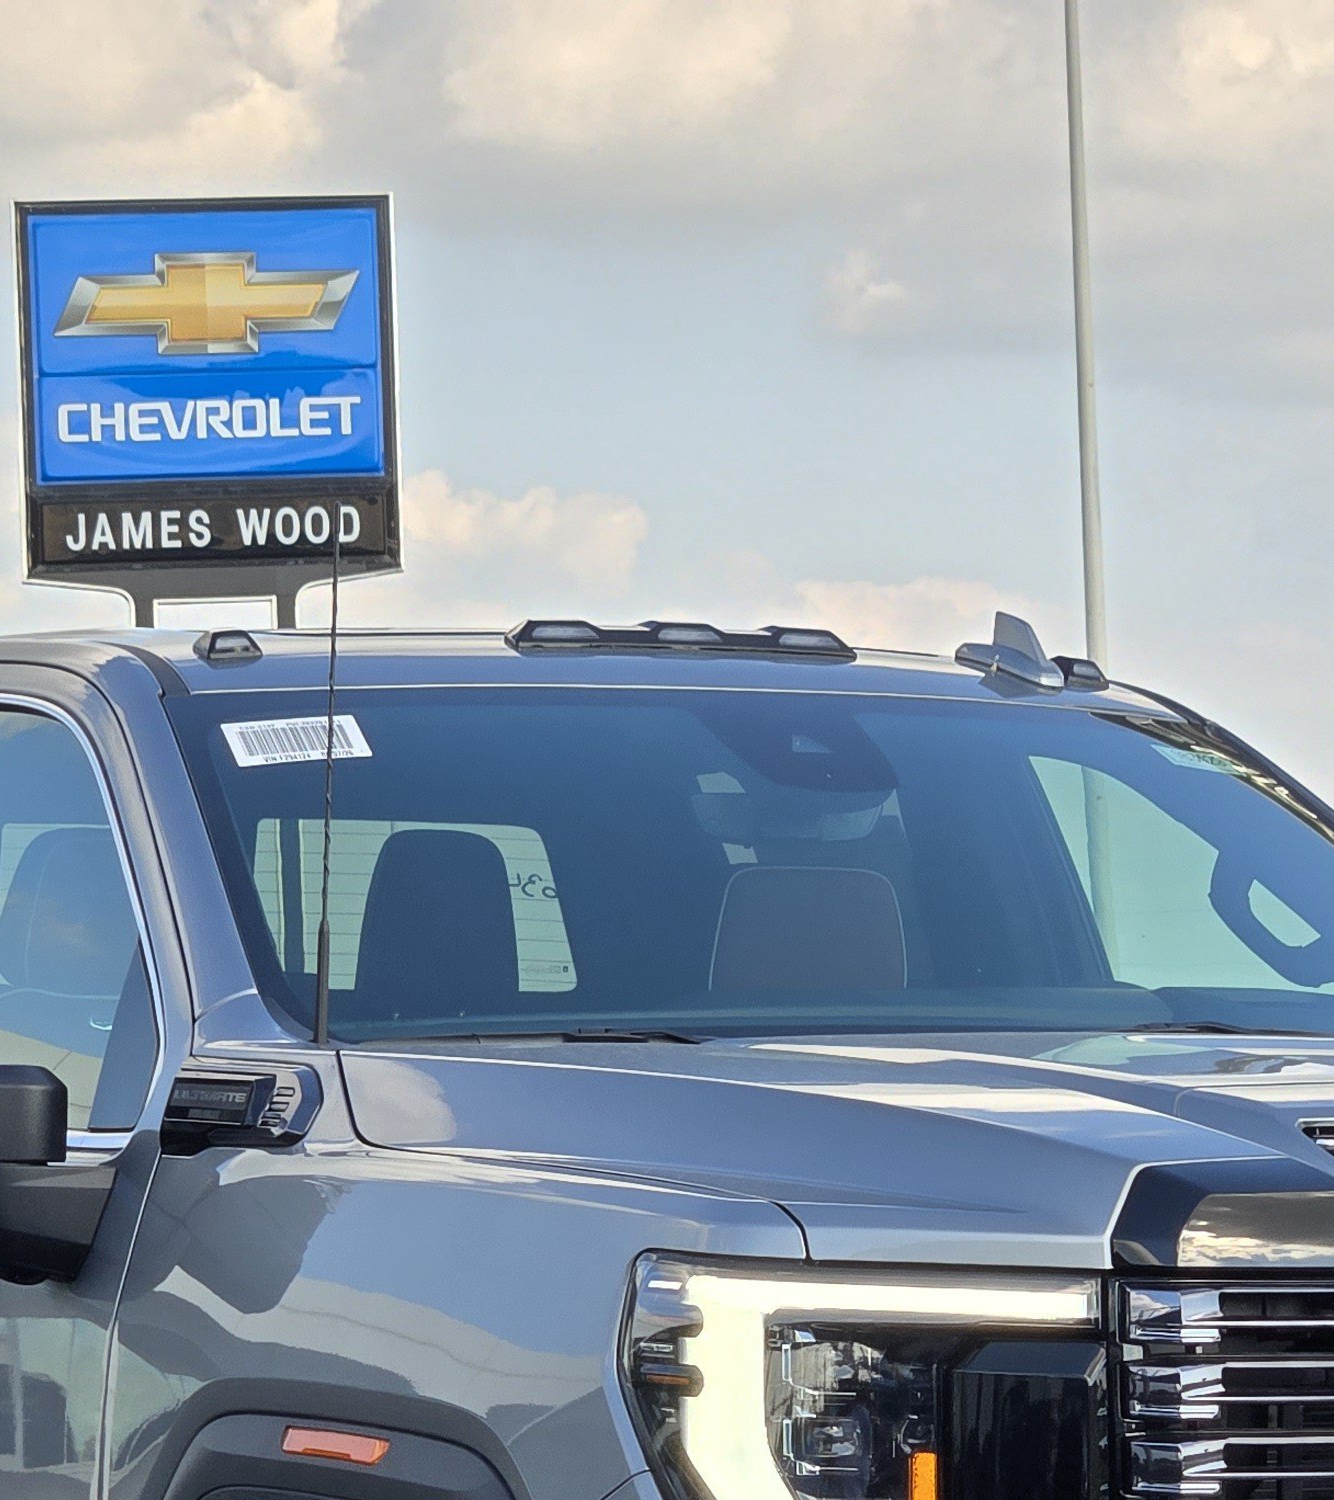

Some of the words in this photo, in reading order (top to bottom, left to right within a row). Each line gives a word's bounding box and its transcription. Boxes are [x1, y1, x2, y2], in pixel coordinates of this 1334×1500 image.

[58, 396, 361, 443] CHEVROLET
[66, 509, 212, 552] JAMES
[236, 505, 361, 547] WOOD
